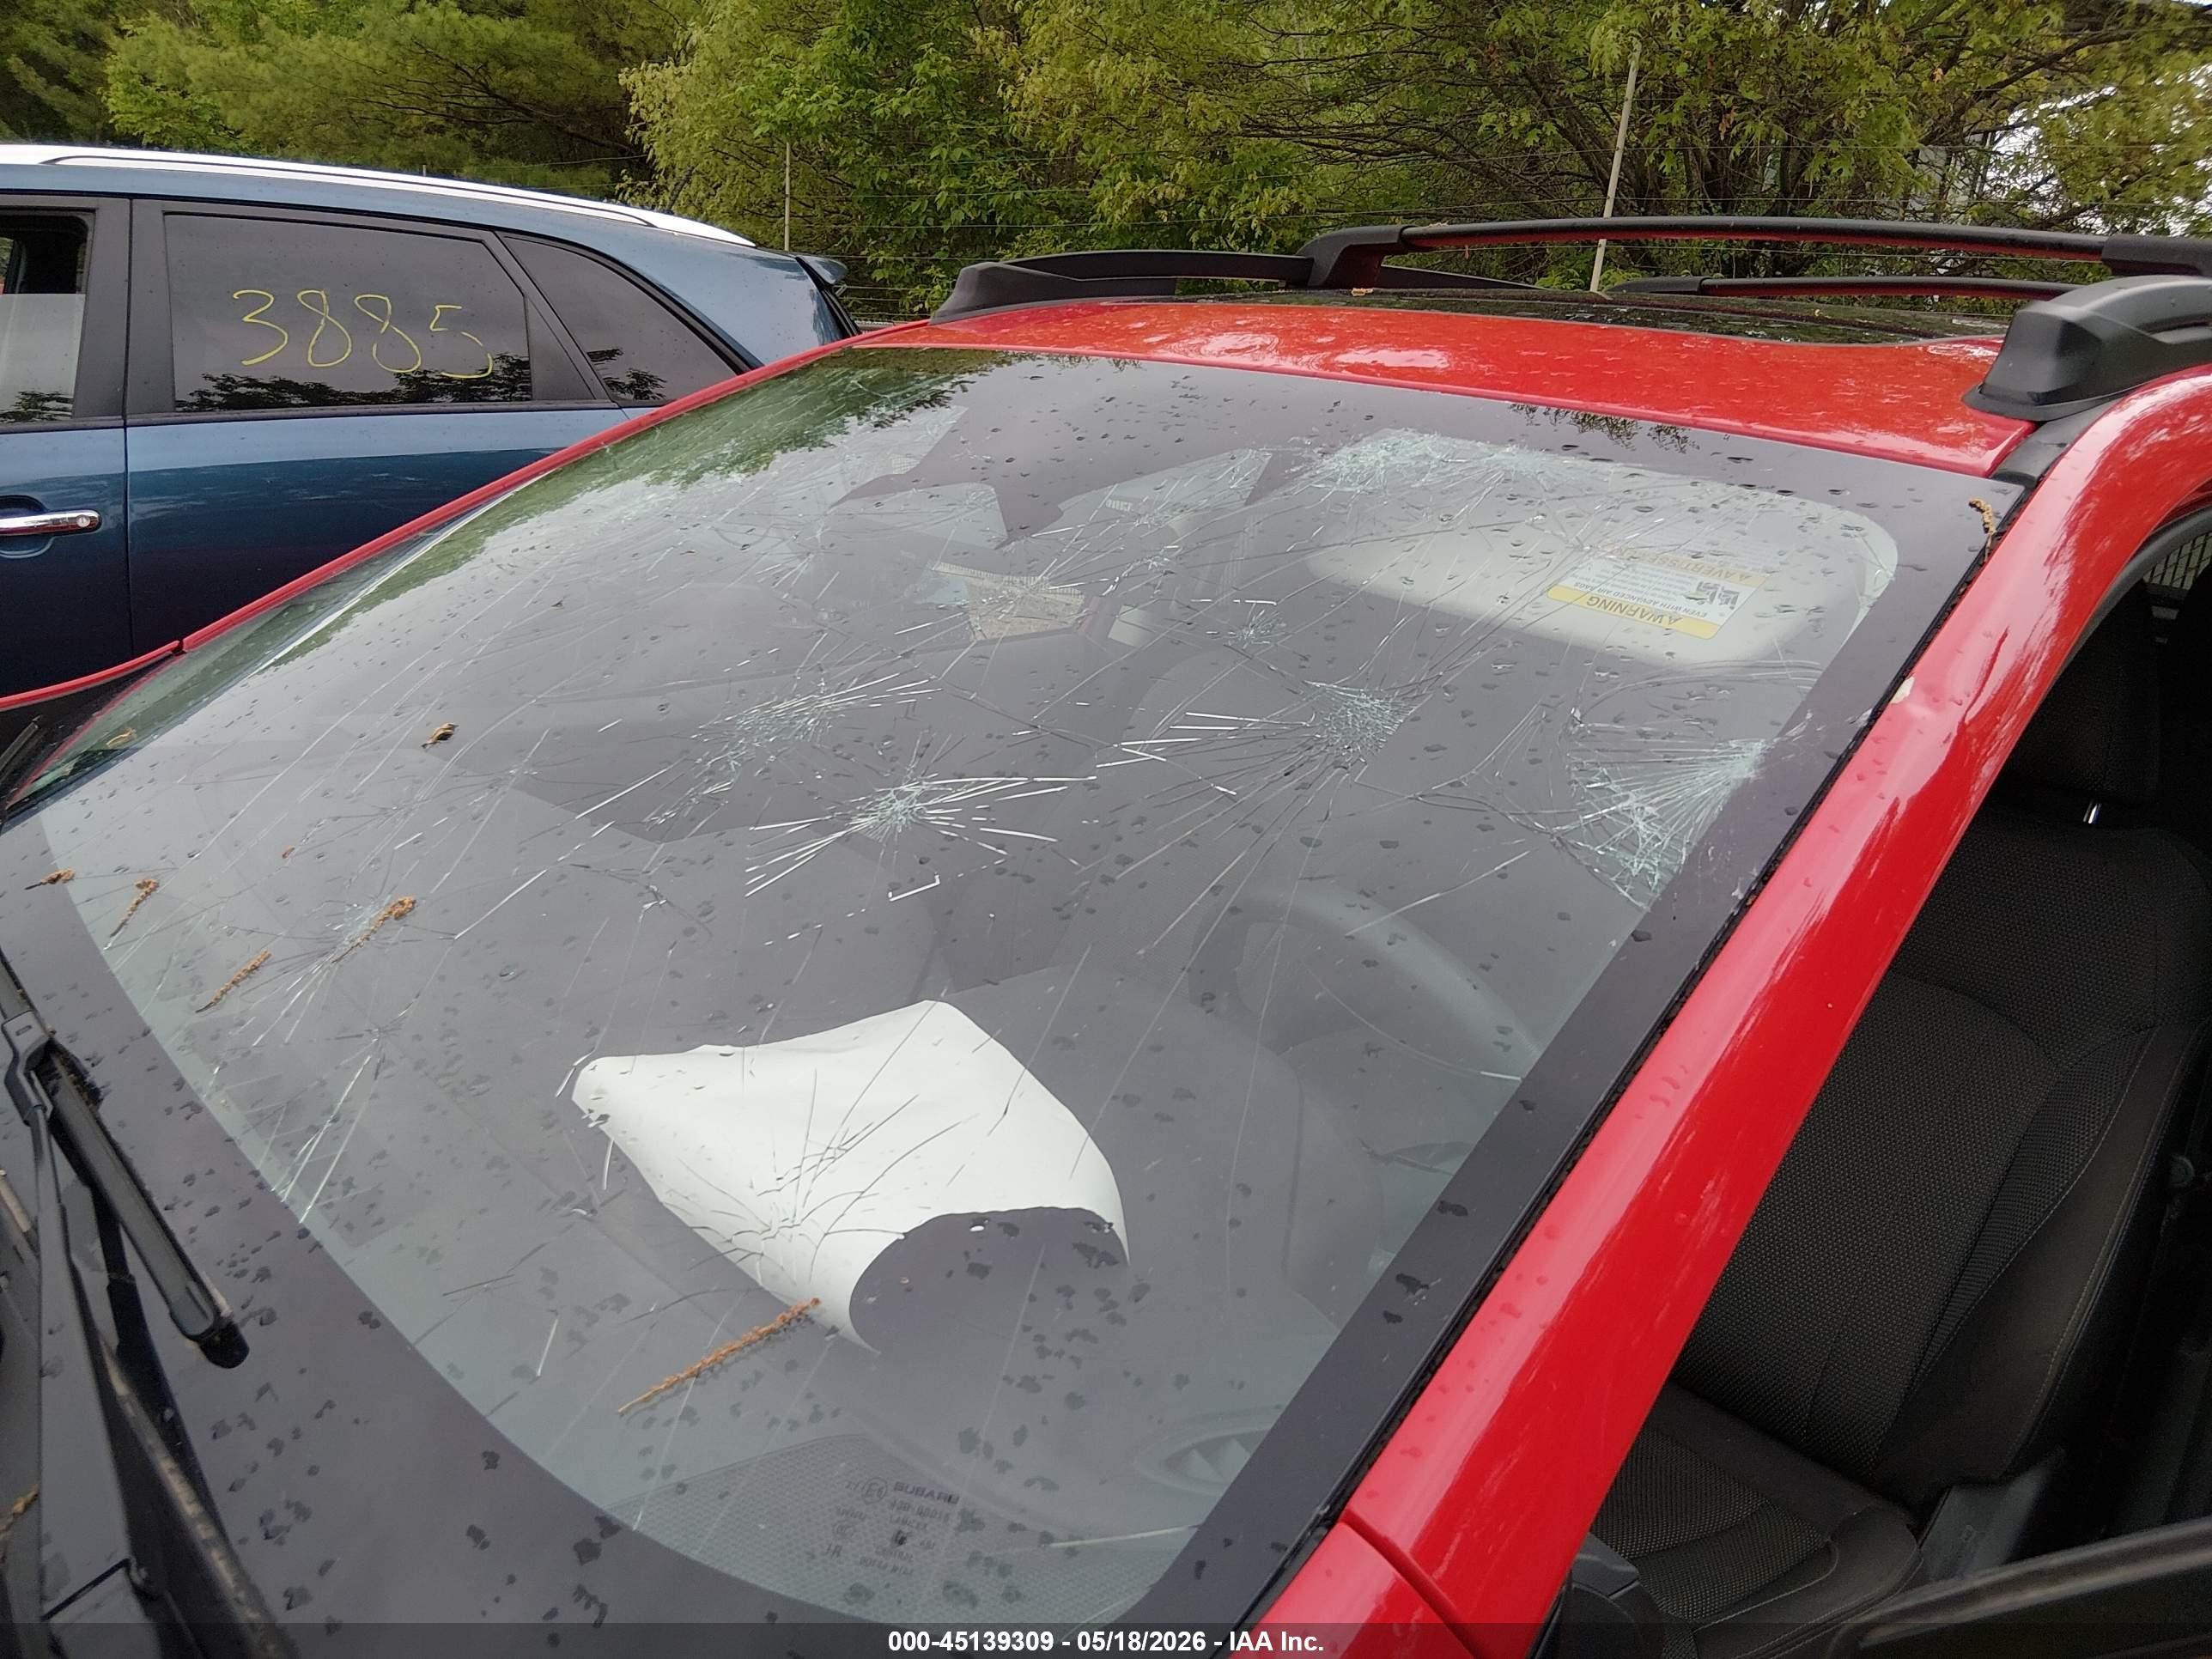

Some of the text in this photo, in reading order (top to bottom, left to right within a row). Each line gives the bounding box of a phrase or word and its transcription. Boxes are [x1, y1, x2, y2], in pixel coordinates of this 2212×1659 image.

[234, 290, 495, 379] 3885
[1587, 595, 1668, 624] WARNING
[893, 1482, 960, 1504] SUBARU
